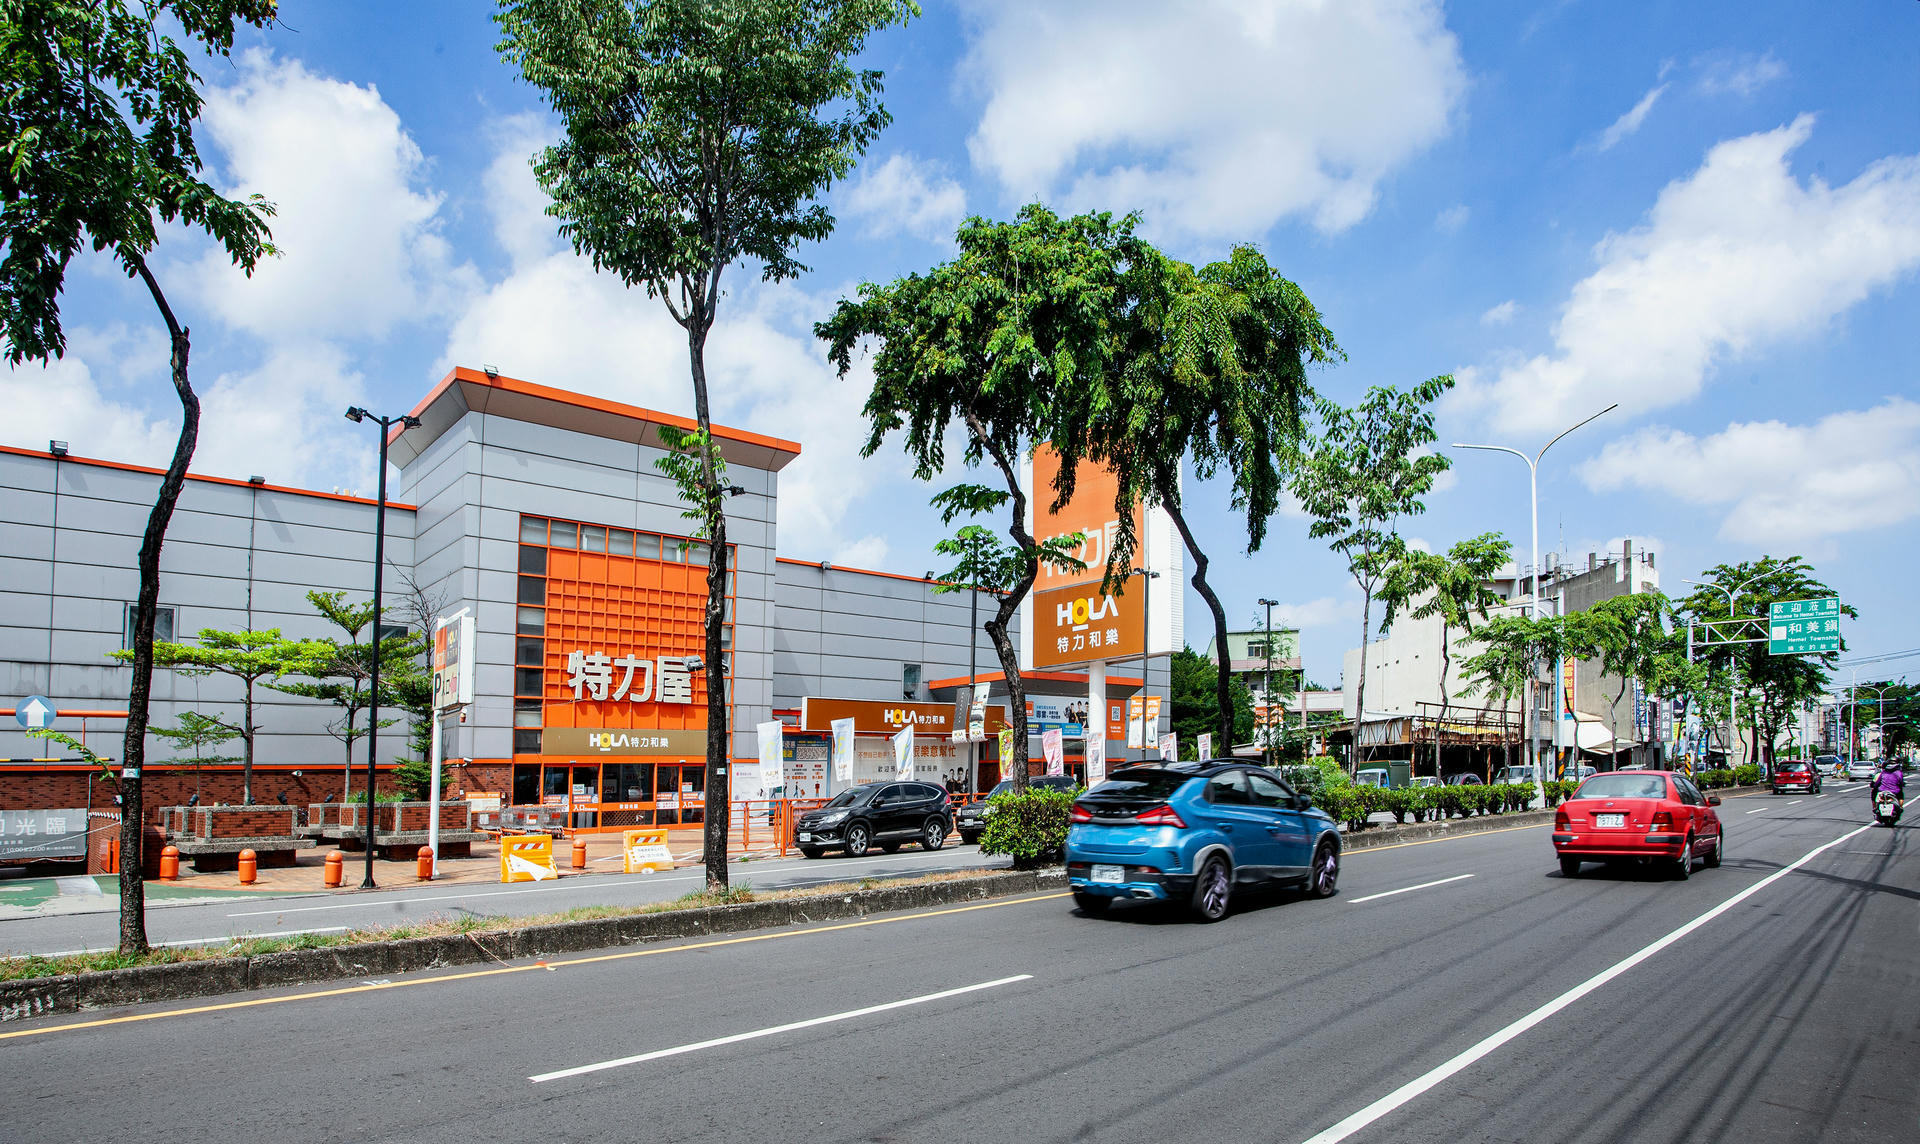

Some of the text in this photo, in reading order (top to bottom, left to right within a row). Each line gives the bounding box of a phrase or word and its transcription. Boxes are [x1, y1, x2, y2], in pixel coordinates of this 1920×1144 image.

[1056, 594, 1119, 632] HOLA
[1788, 619, 1838, 635] 和美鎮
[1057, 628, 1119, 654] 特力和樂
[567, 650, 692, 704] 特力屋
[884, 708, 918, 728] HOLA
[589, 732, 669, 751] HOLA 特力和樂
[573, 804, 586, 812] 入口
